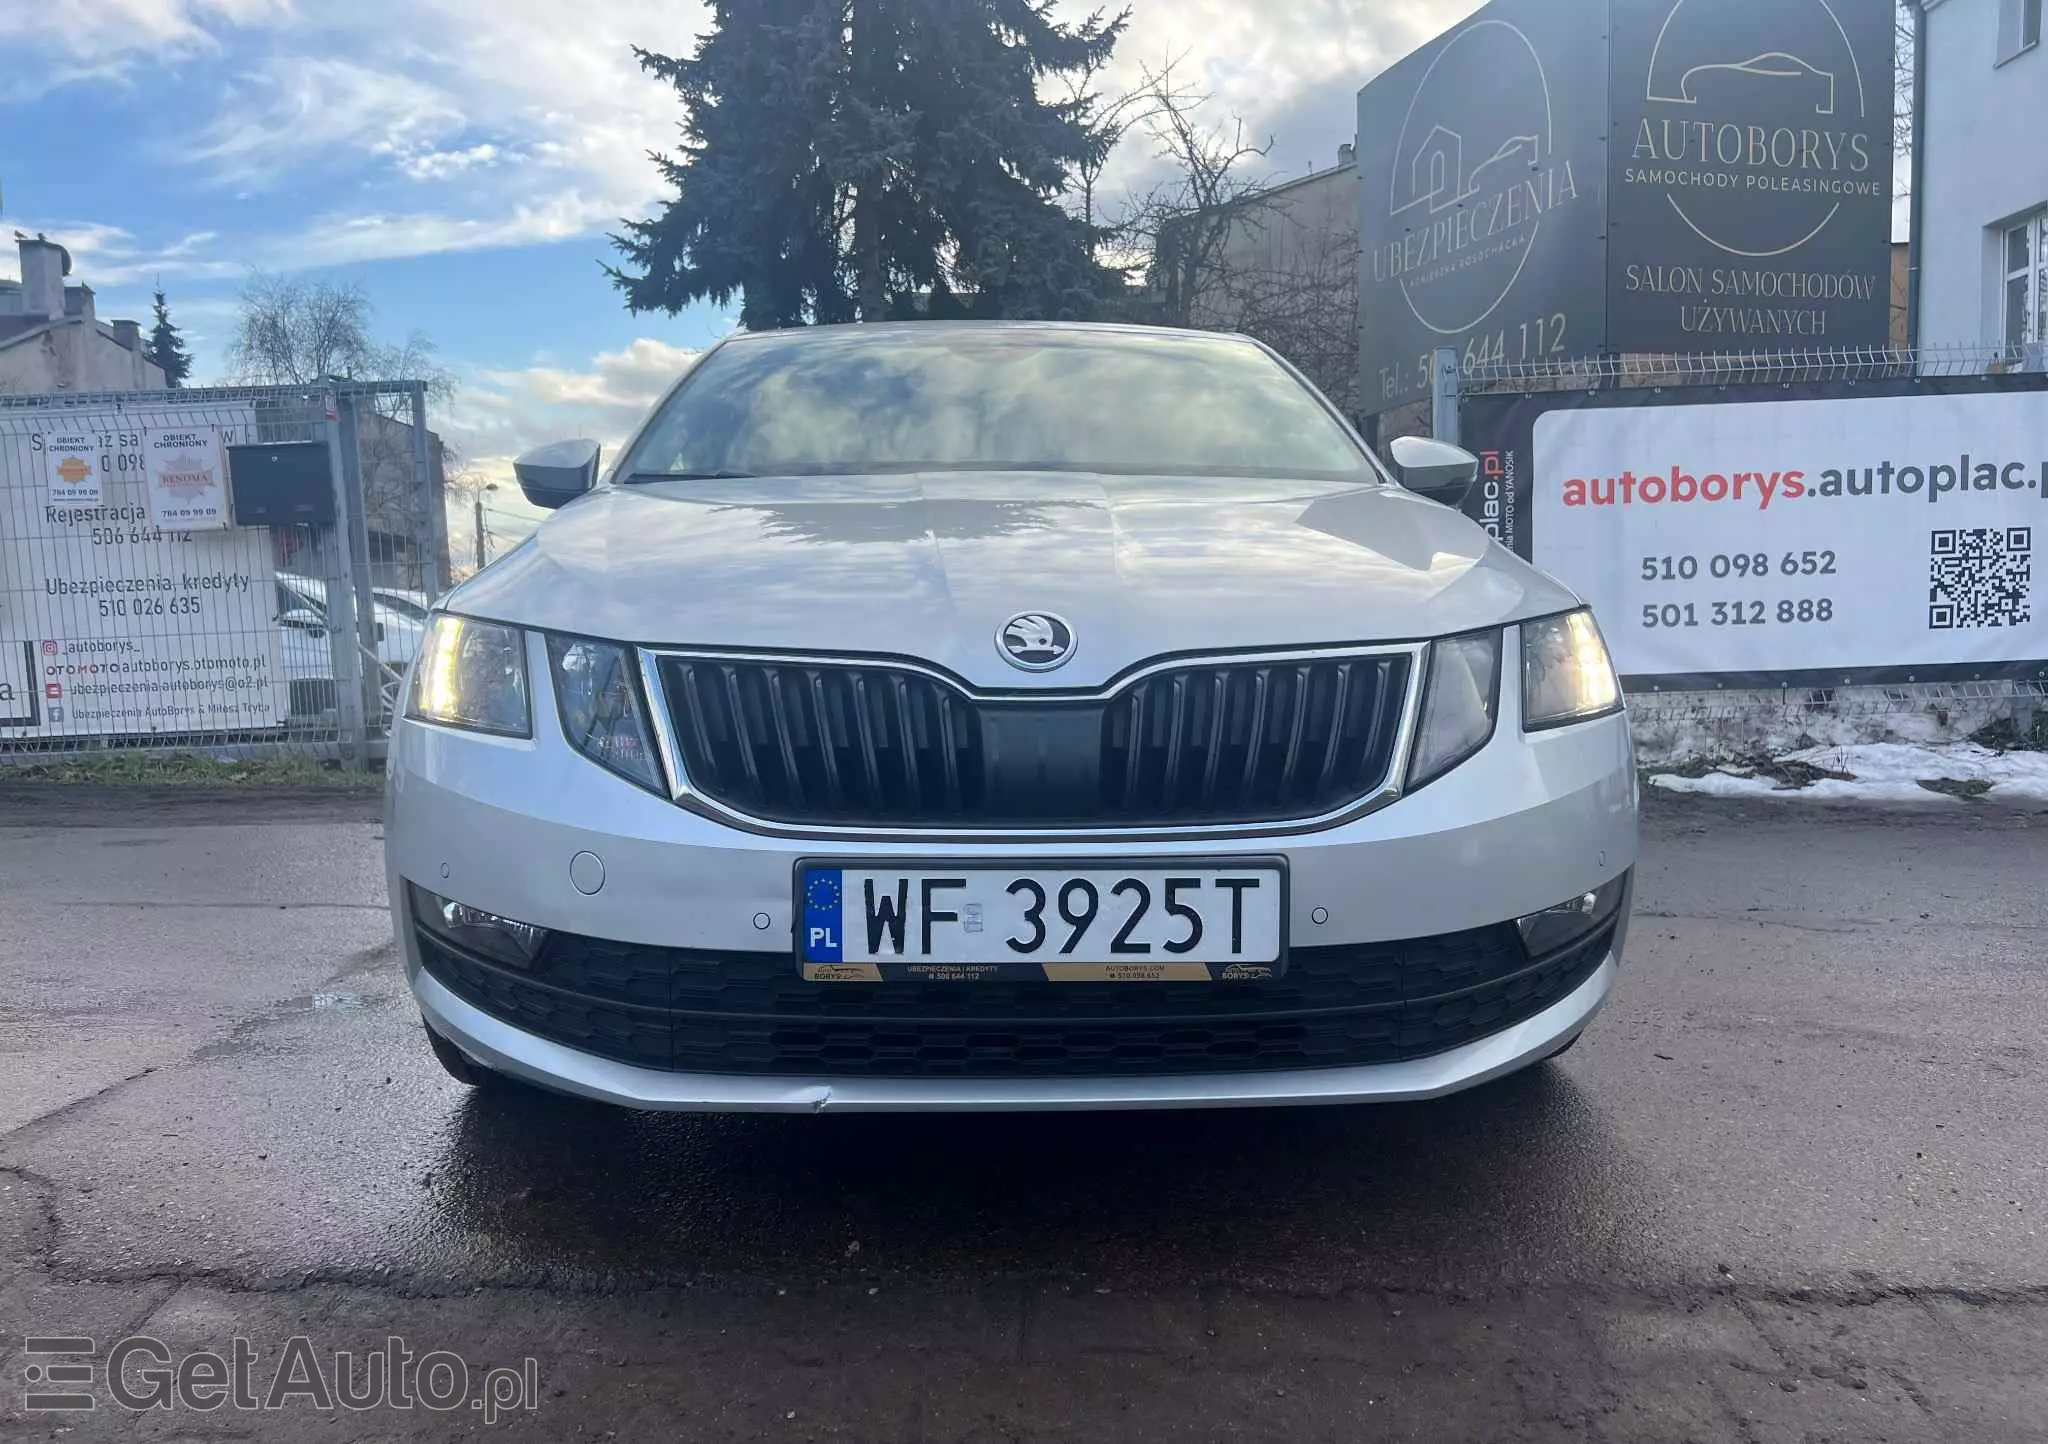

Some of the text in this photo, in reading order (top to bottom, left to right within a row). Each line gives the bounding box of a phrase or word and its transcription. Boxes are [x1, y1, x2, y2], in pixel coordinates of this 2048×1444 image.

[1631, 117, 1870, 172] AUTOBORYS
[1624, 168, 1880, 196] SAMOCHODY POLEASINGOWE
[1373, 160, 1579, 282] UBEZPIECZENIA
[1625, 264, 1876, 301] SALON SAMOCHODÓW
[1680, 297, 1826, 336] UŻYWANYCH
[1462, 329, 1505, 376] 644
[1519, 312, 1567, 359] 112
[153, 439, 209, 449] CHRONIONY
[163, 433, 197, 442] OBIEKT
[1504, 450, 1514, 490] YANOSIK
[1504, 491, 1514, 503] od
[45, 502, 145, 527] Rejestracja
[1504, 504, 1514, 534] MOTO
[93, 527, 124, 545] 506
[130, 525, 162, 544] 644
[1641, 550, 1837, 581] 510 098 652
[182, 571, 250, 593] kredyty
[99, 596, 201, 617] 510 026 635
[1641, 598, 1834, 628] 501 312 888
[46, 663, 119, 677] OTOMOTO
[864, 877, 1261, 955] WF 3925T
[810, 927, 837, 949] PL
